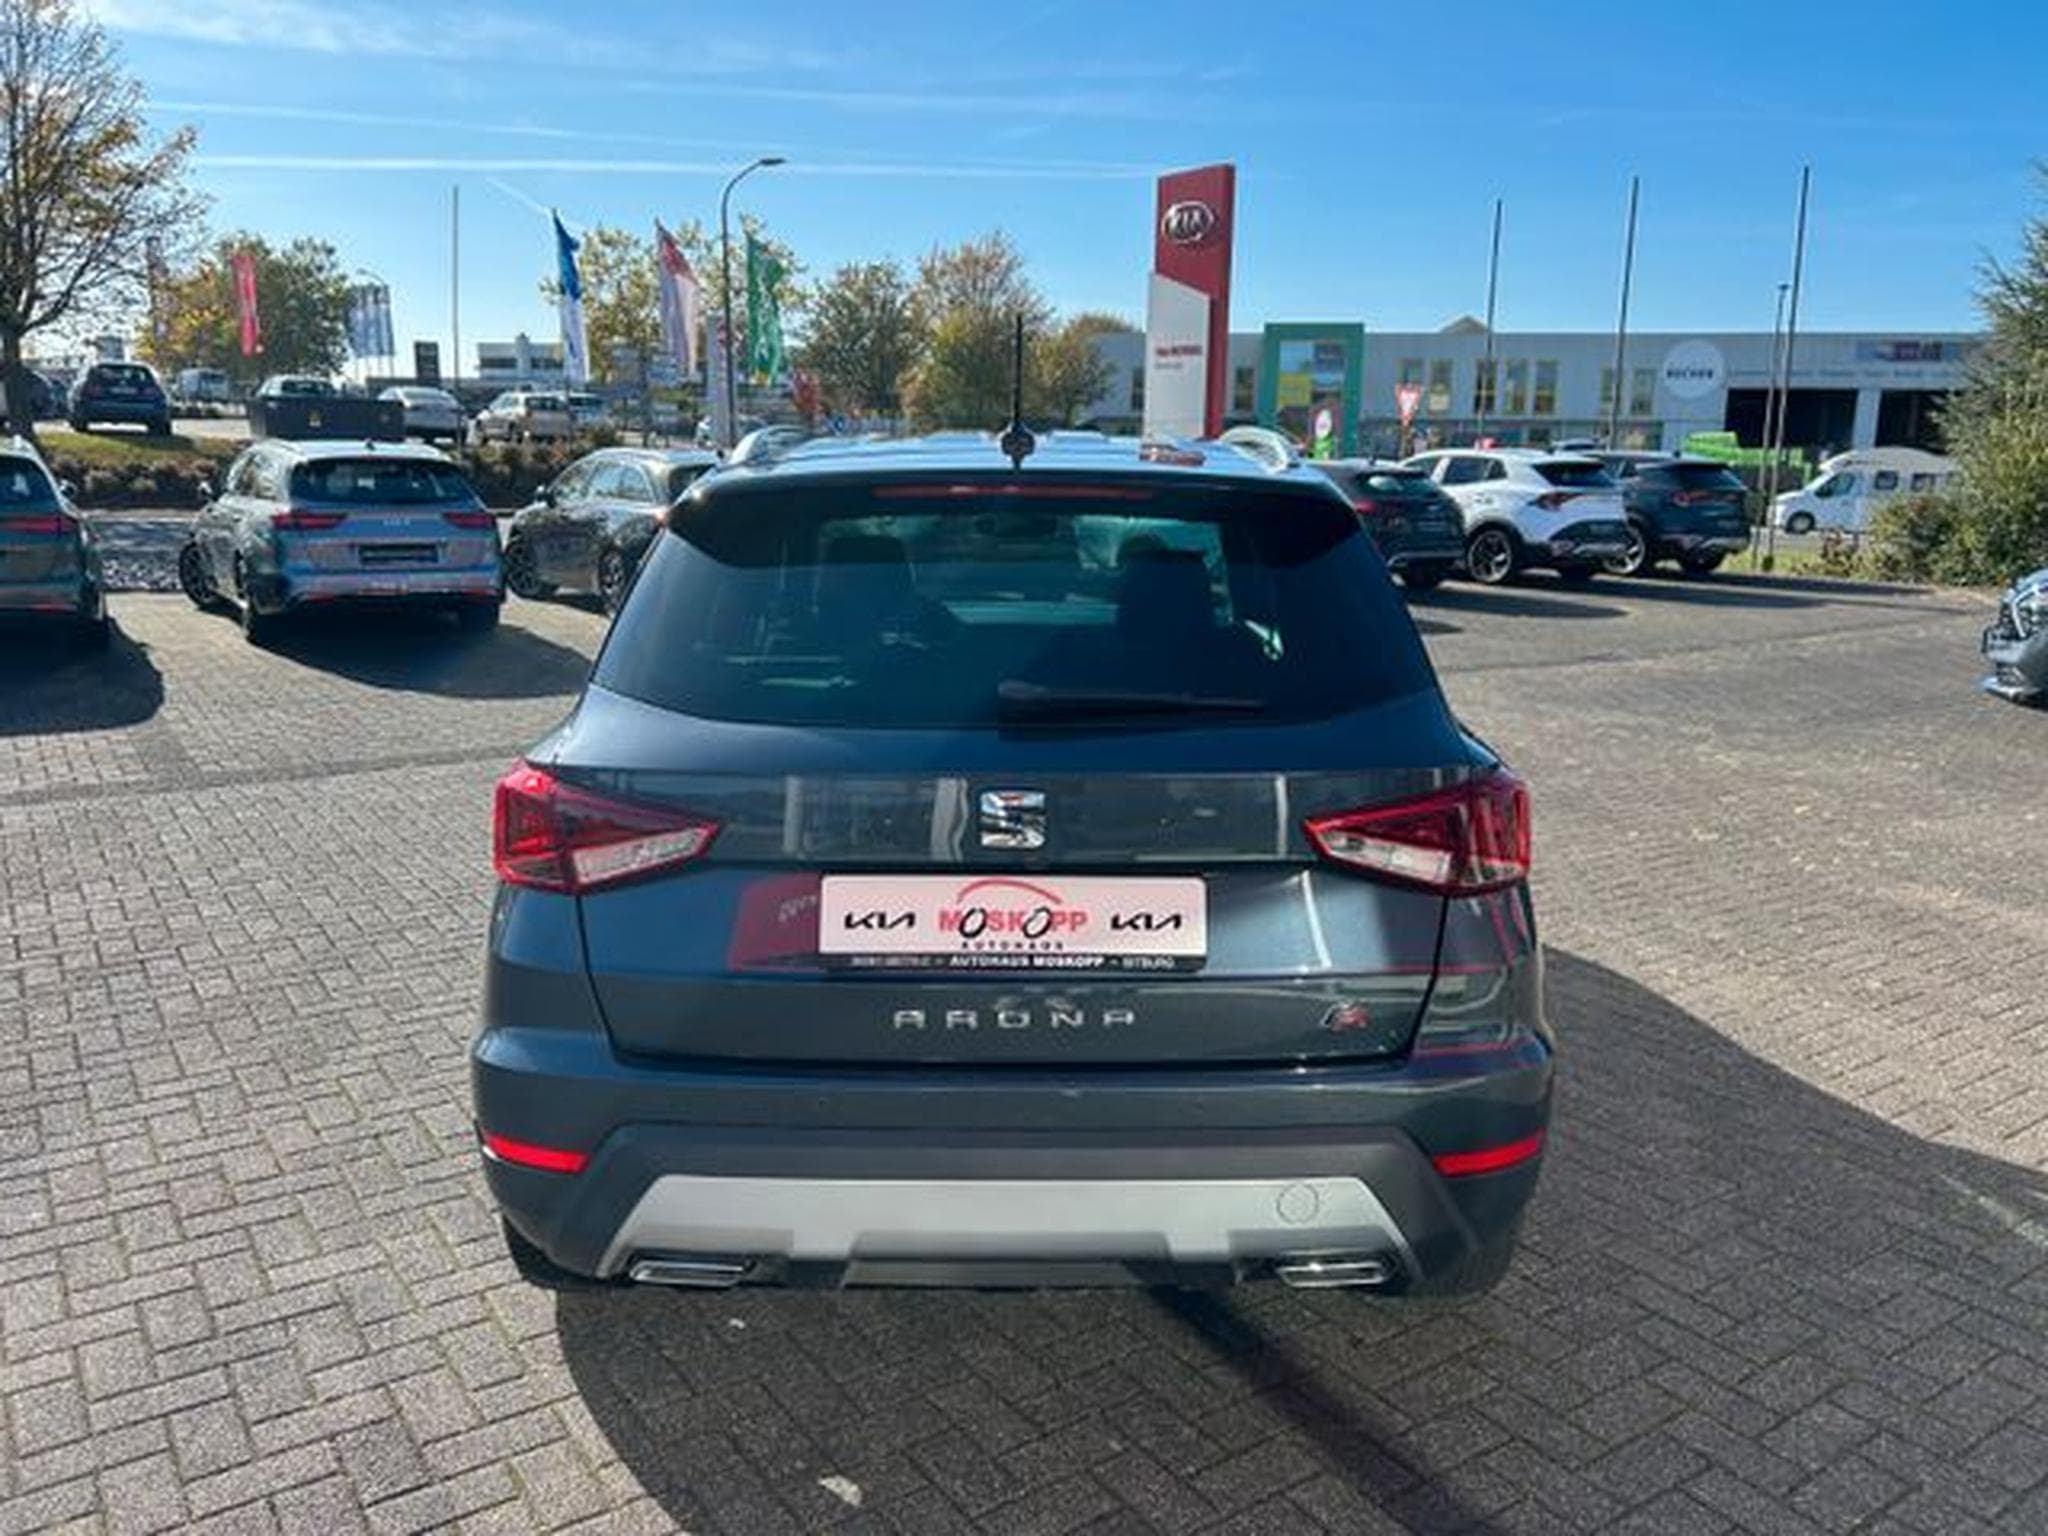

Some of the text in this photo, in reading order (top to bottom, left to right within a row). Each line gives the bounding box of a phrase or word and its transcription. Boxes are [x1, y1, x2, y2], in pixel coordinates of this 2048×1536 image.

[938, 907, 1088, 939] MOSKOPP
[951, 955, 1029, 967] AUTOHAUS
[1034, 955, 1105, 967] MOSKOPP
[894, 1009, 1135, 1028] ARONA
